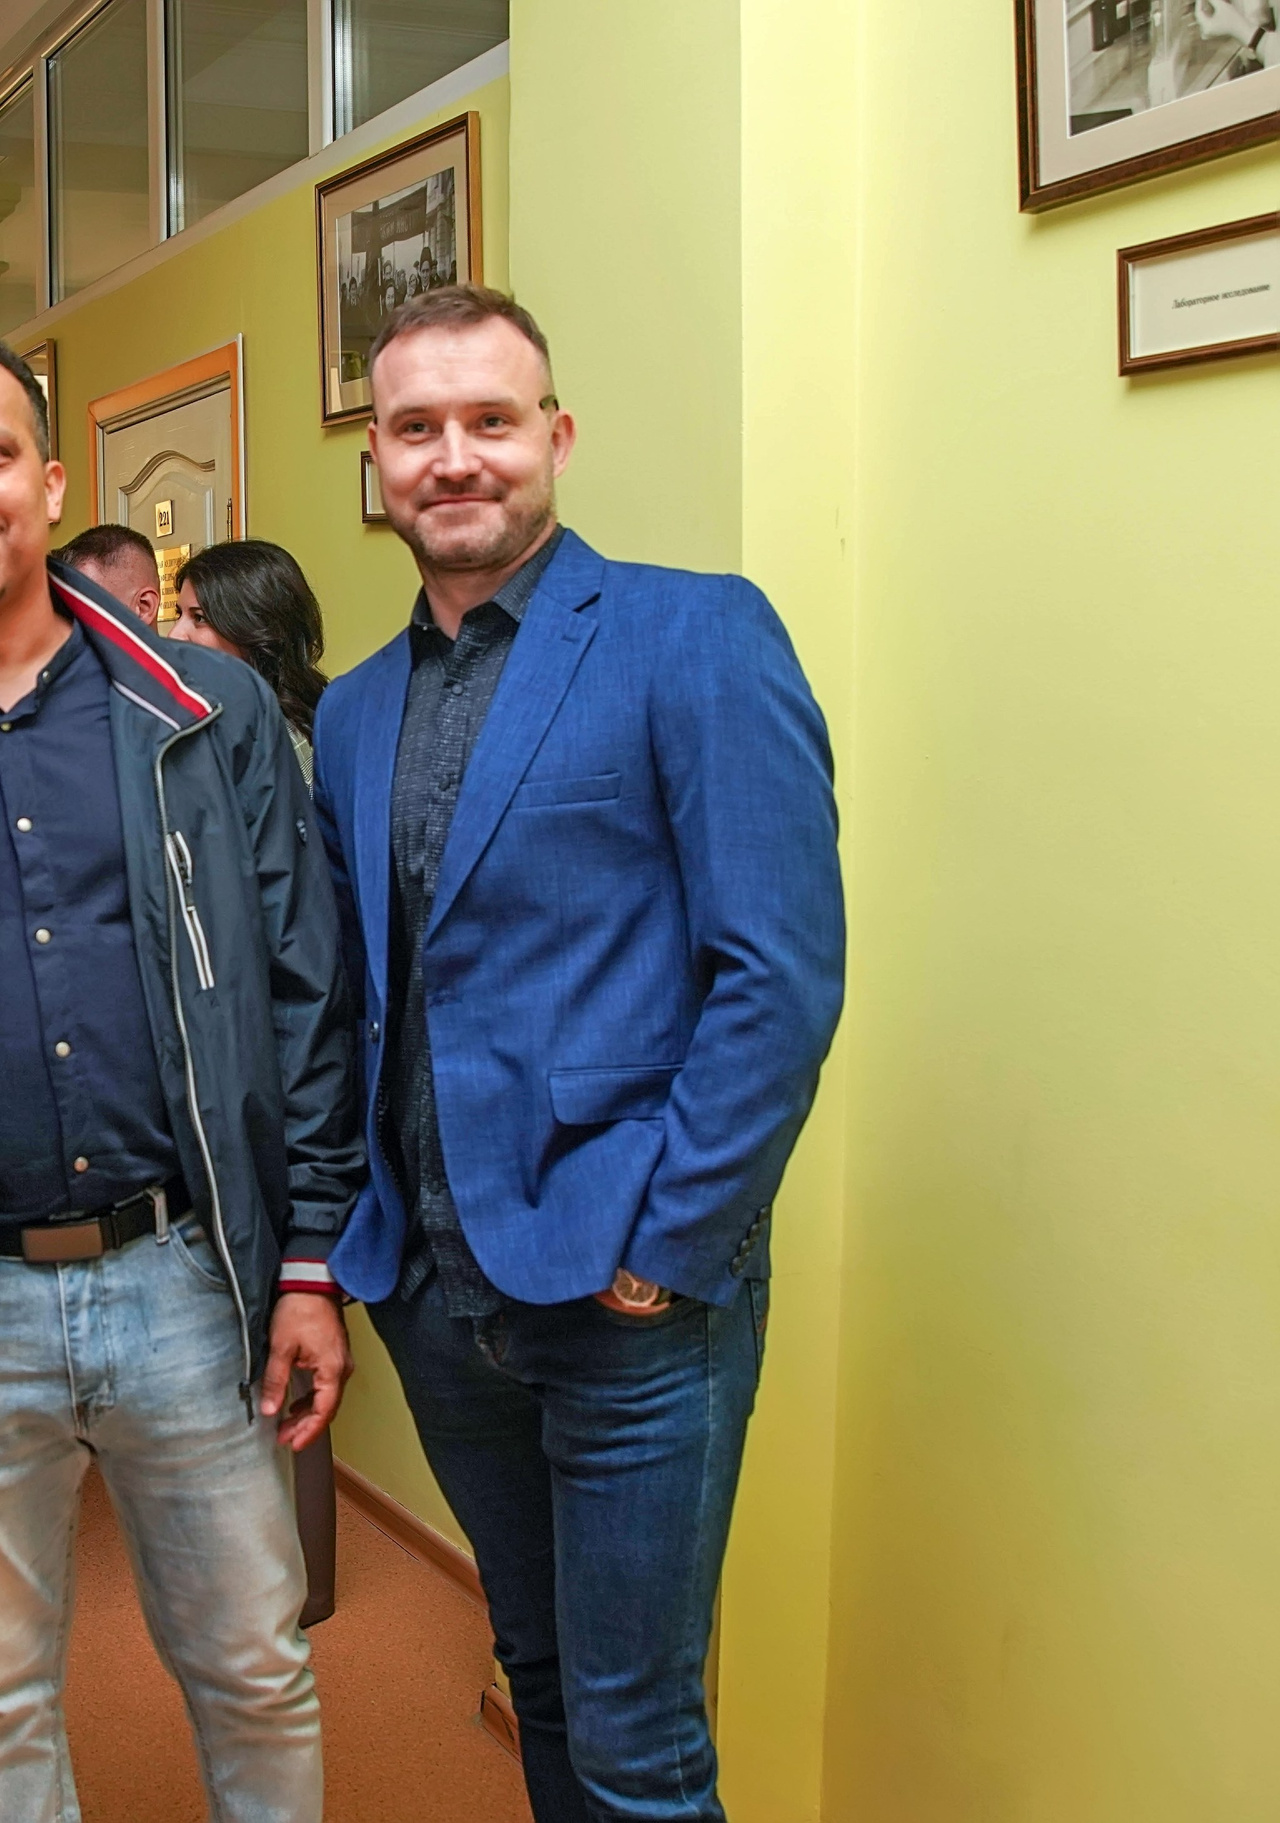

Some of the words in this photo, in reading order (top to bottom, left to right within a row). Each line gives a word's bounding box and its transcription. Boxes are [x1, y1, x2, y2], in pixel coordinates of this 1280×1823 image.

[1171, 293, 1220, 309] Лабораторное
[1221, 283, 1271, 300] исследование
[159, 511, 170, 527] 221
